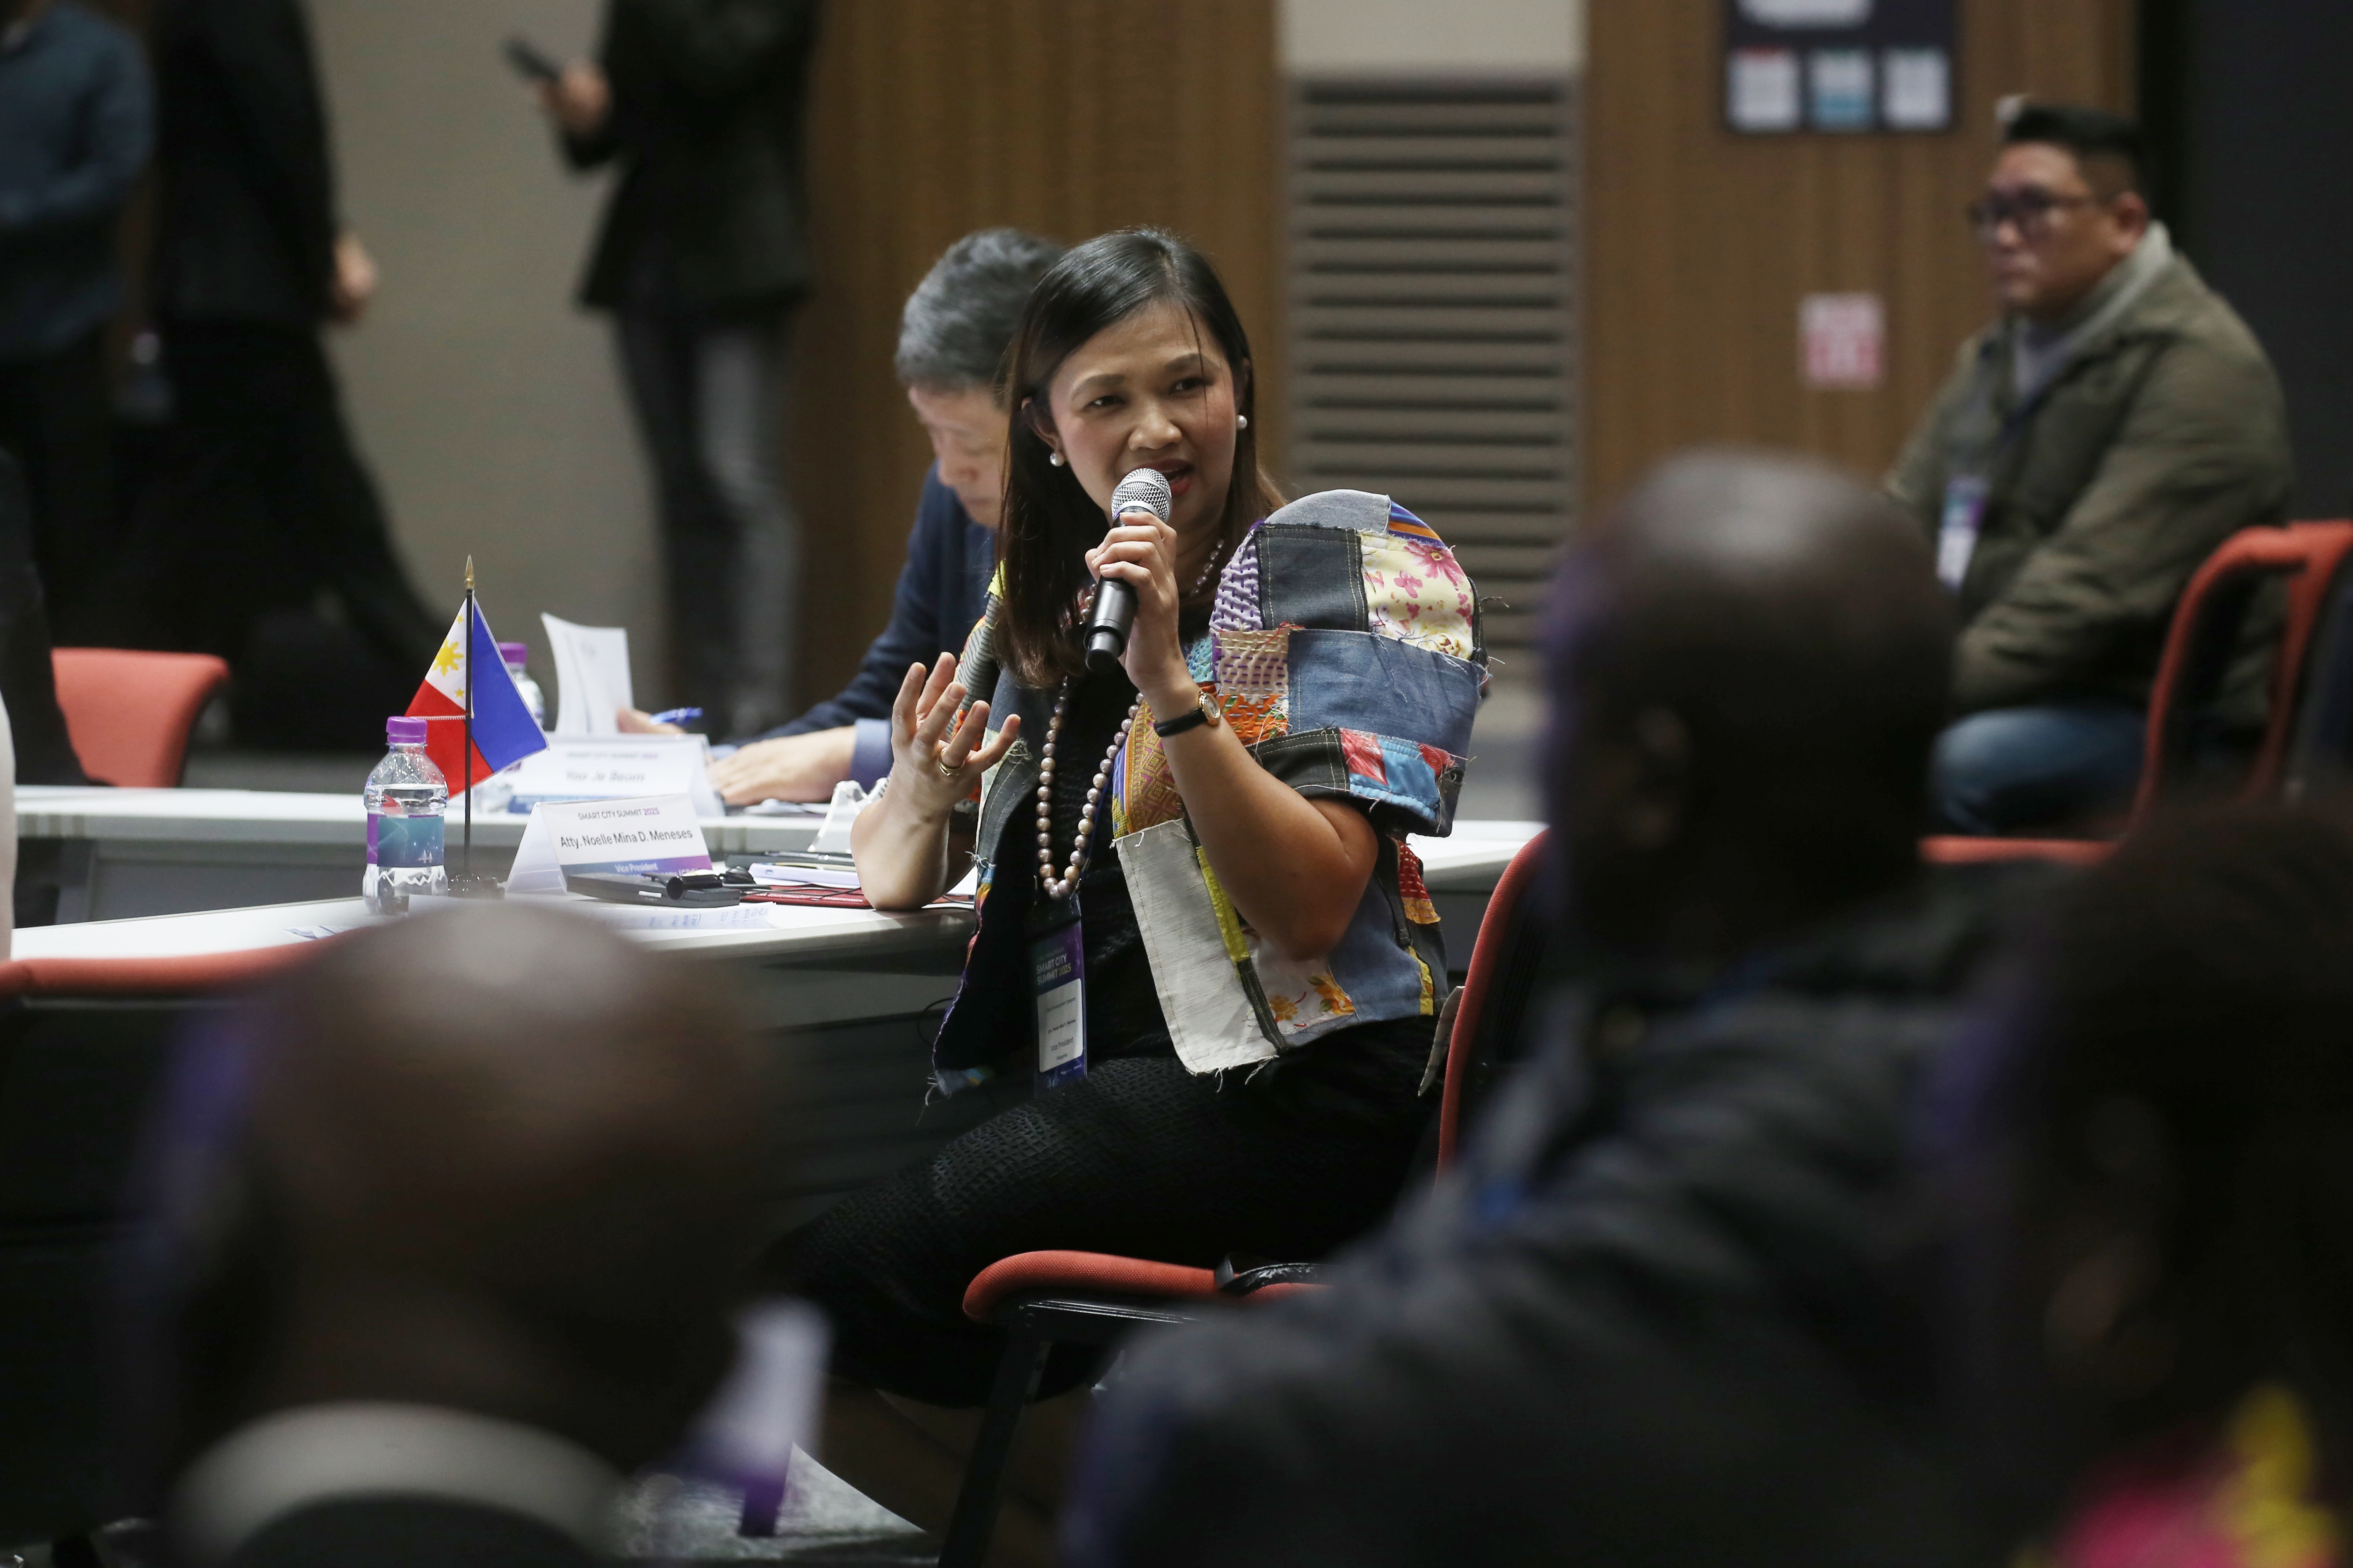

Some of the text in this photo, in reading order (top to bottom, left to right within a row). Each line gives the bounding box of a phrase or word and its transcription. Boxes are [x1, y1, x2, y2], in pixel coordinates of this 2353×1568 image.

[617, 809, 642, 817] SUMMIT
[561, 829, 693, 849] Atty. Noelle Mina D. Meneses
[614, 862, 658, 873] Vice President
[1036, 959, 1054, 974] SMART
[1055, 953, 1067, 966] CITY
[1037, 963, 1071, 985] SUMMIT 2025
[1058, 1037, 1073, 1048] President
